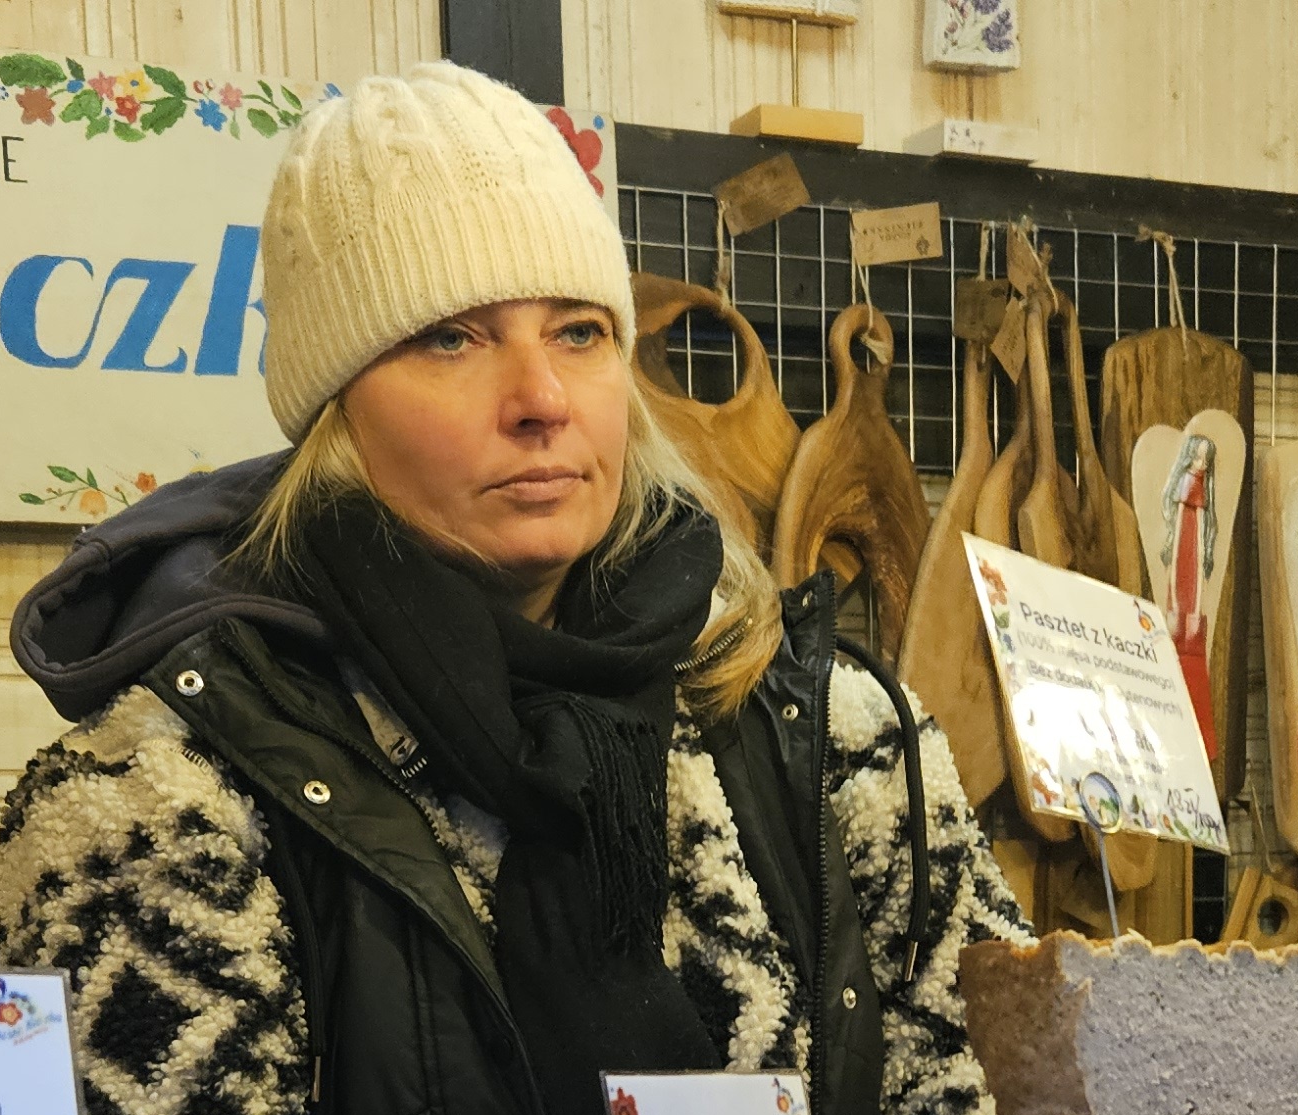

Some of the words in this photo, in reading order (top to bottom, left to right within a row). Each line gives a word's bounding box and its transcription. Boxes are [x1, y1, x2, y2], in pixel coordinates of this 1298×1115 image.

[1019, 601, 1089, 641] Pasztet
[1091, 627, 1102, 646] z
[1103, 627, 1158, 664] kaczki
